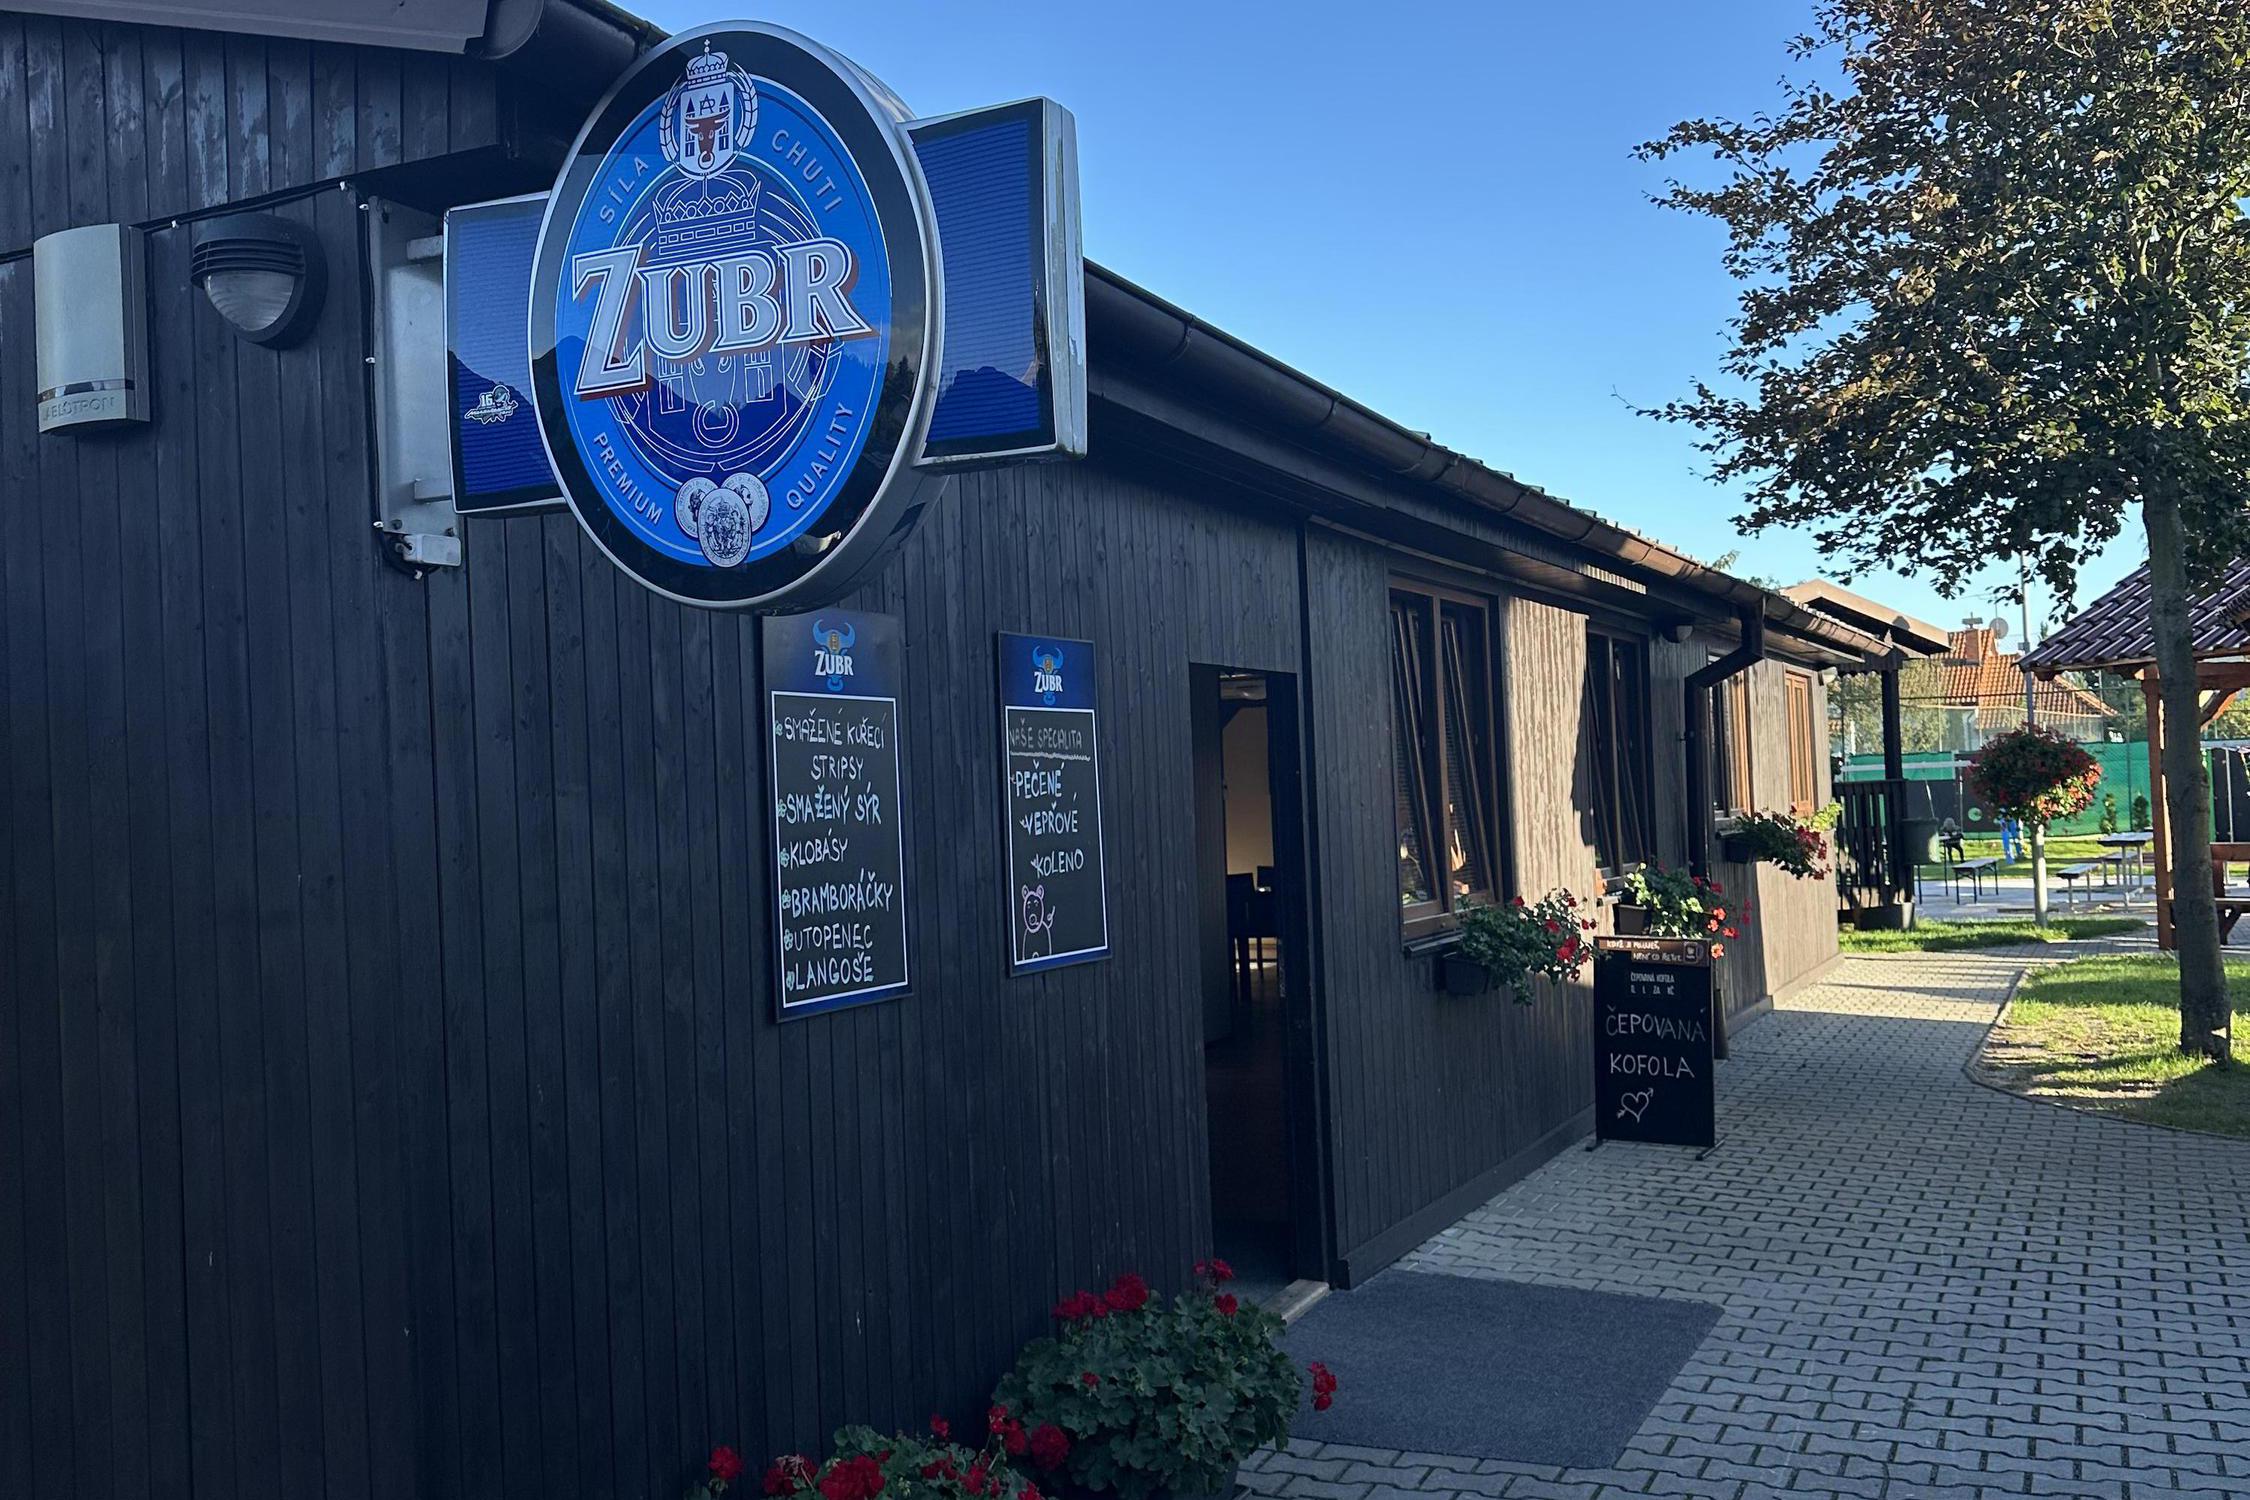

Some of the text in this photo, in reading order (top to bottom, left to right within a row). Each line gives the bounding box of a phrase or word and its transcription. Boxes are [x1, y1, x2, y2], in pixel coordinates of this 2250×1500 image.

[600, 156, 650, 224] SÍLA
[771, 129, 843, 212] CHUTI
[572, 236, 874, 396] ZUBR
[786, 402, 853, 509] QUALITY
[593, 431, 664, 525] PREMIUM
[814, 650, 854, 676] ZUBR
[1034, 671, 1063, 693] ZUBR
[784, 708, 887, 749] SMAŽENÉ KUŘECÍ
[1009, 718, 1082, 750] NAŠE SPECIALITA
[811, 755, 864, 781] STRIPSY
[1015, 759, 1065, 799] PEČENÉ
[786, 782, 882, 825] SMAŽENÝ SÝR
[1024, 792, 1079, 836] VEPŘOVÉ
[790, 828, 848, 870] KLOBÁSY
[1035, 849, 1084, 879] KOLENO
[791, 868, 894, 919] BRAMBORÁČKY
[794, 922, 873, 951] UTOPENEC
[795, 951, 875, 990] LANGOŠE
[1606, 1004, 1706, 1042] ČEPOVANÁ
[1610, 1053, 1695, 1079] KOFOLA
